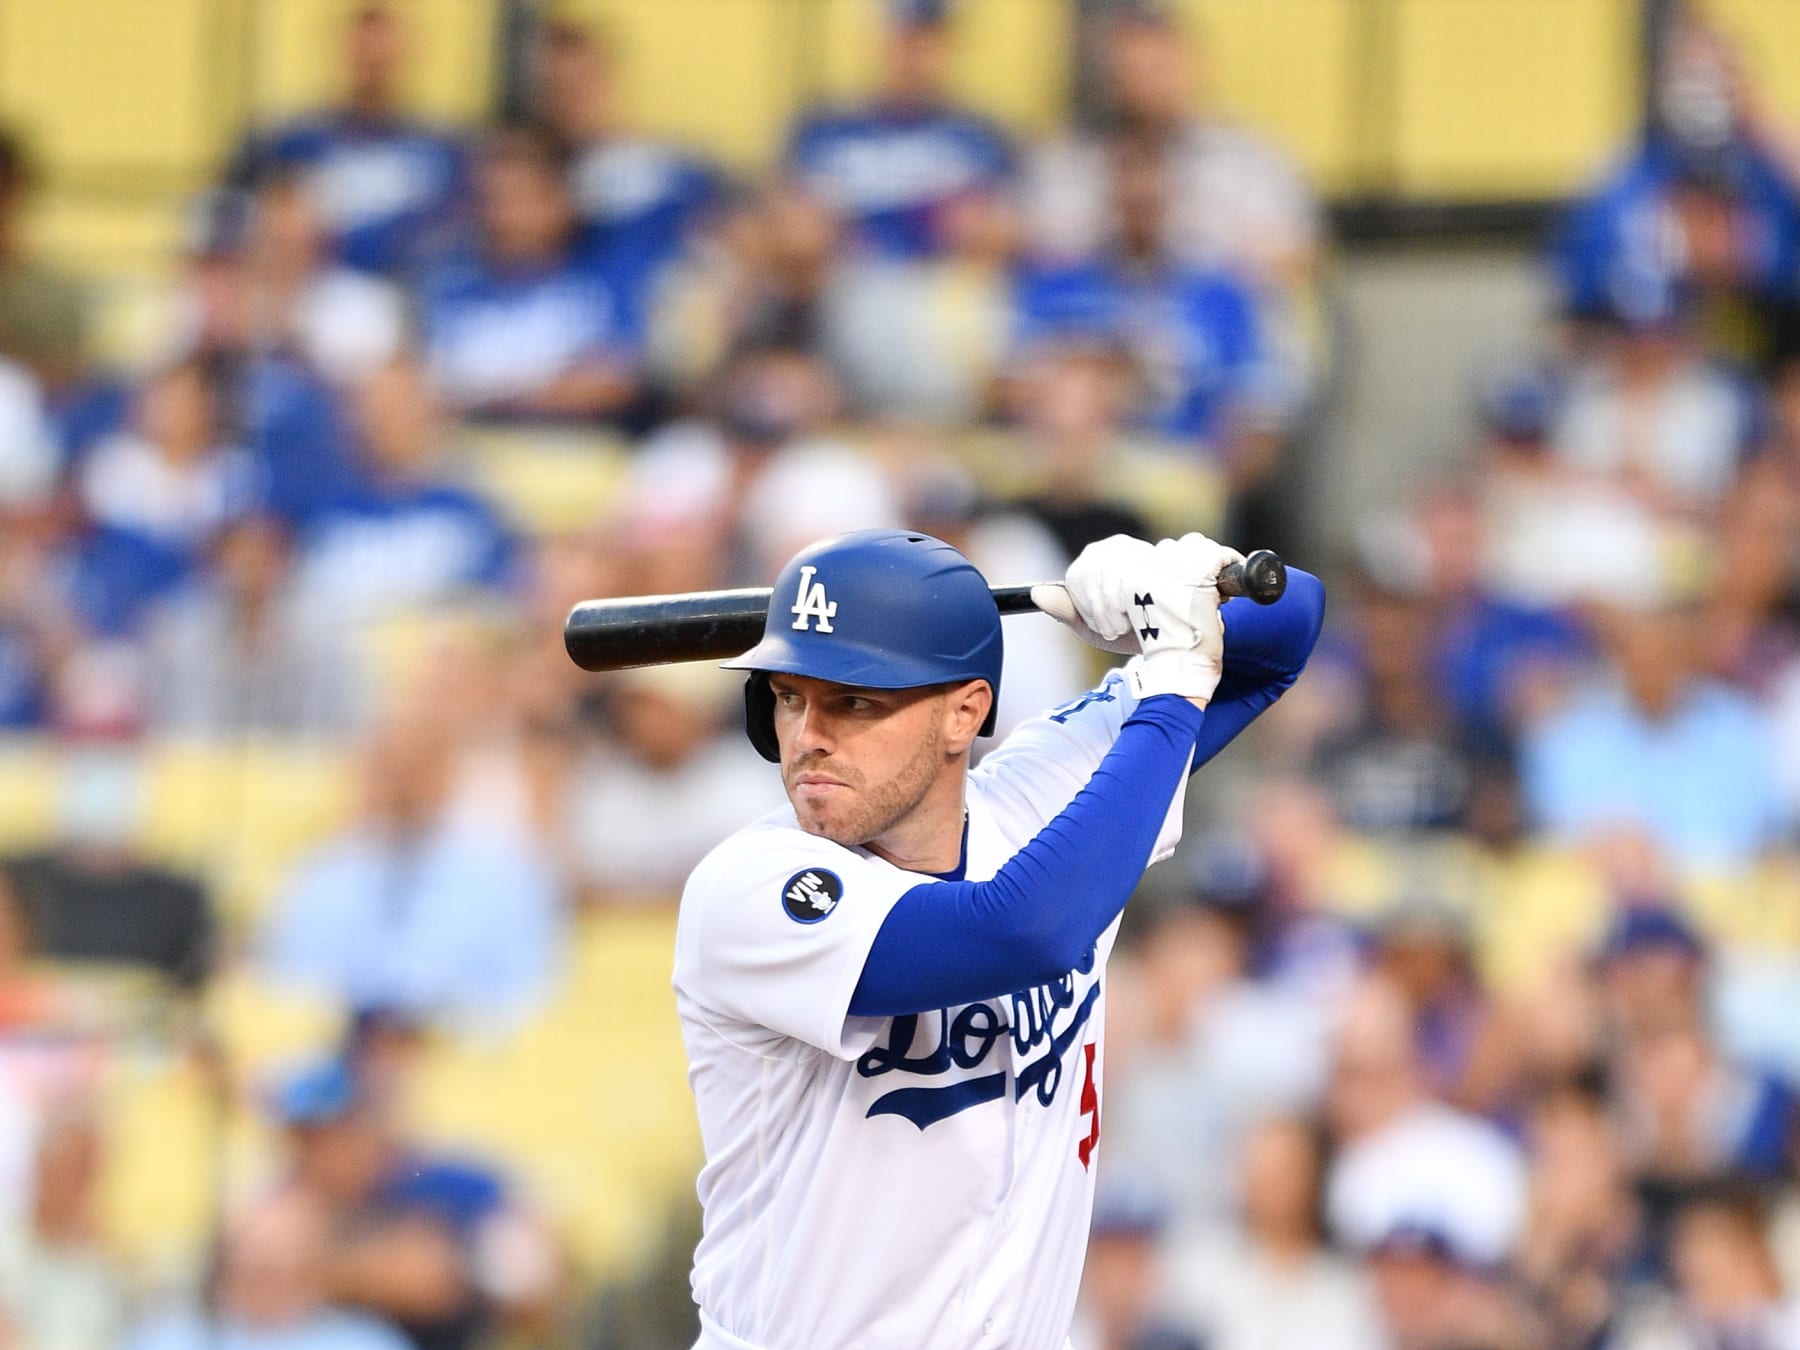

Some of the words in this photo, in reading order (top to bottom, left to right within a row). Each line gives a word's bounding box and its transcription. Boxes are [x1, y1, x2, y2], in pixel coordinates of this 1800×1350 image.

[791, 566, 838, 634] LA
[786, 871, 824, 903] VIN
[857, 948, 1097, 1108] Dodg
